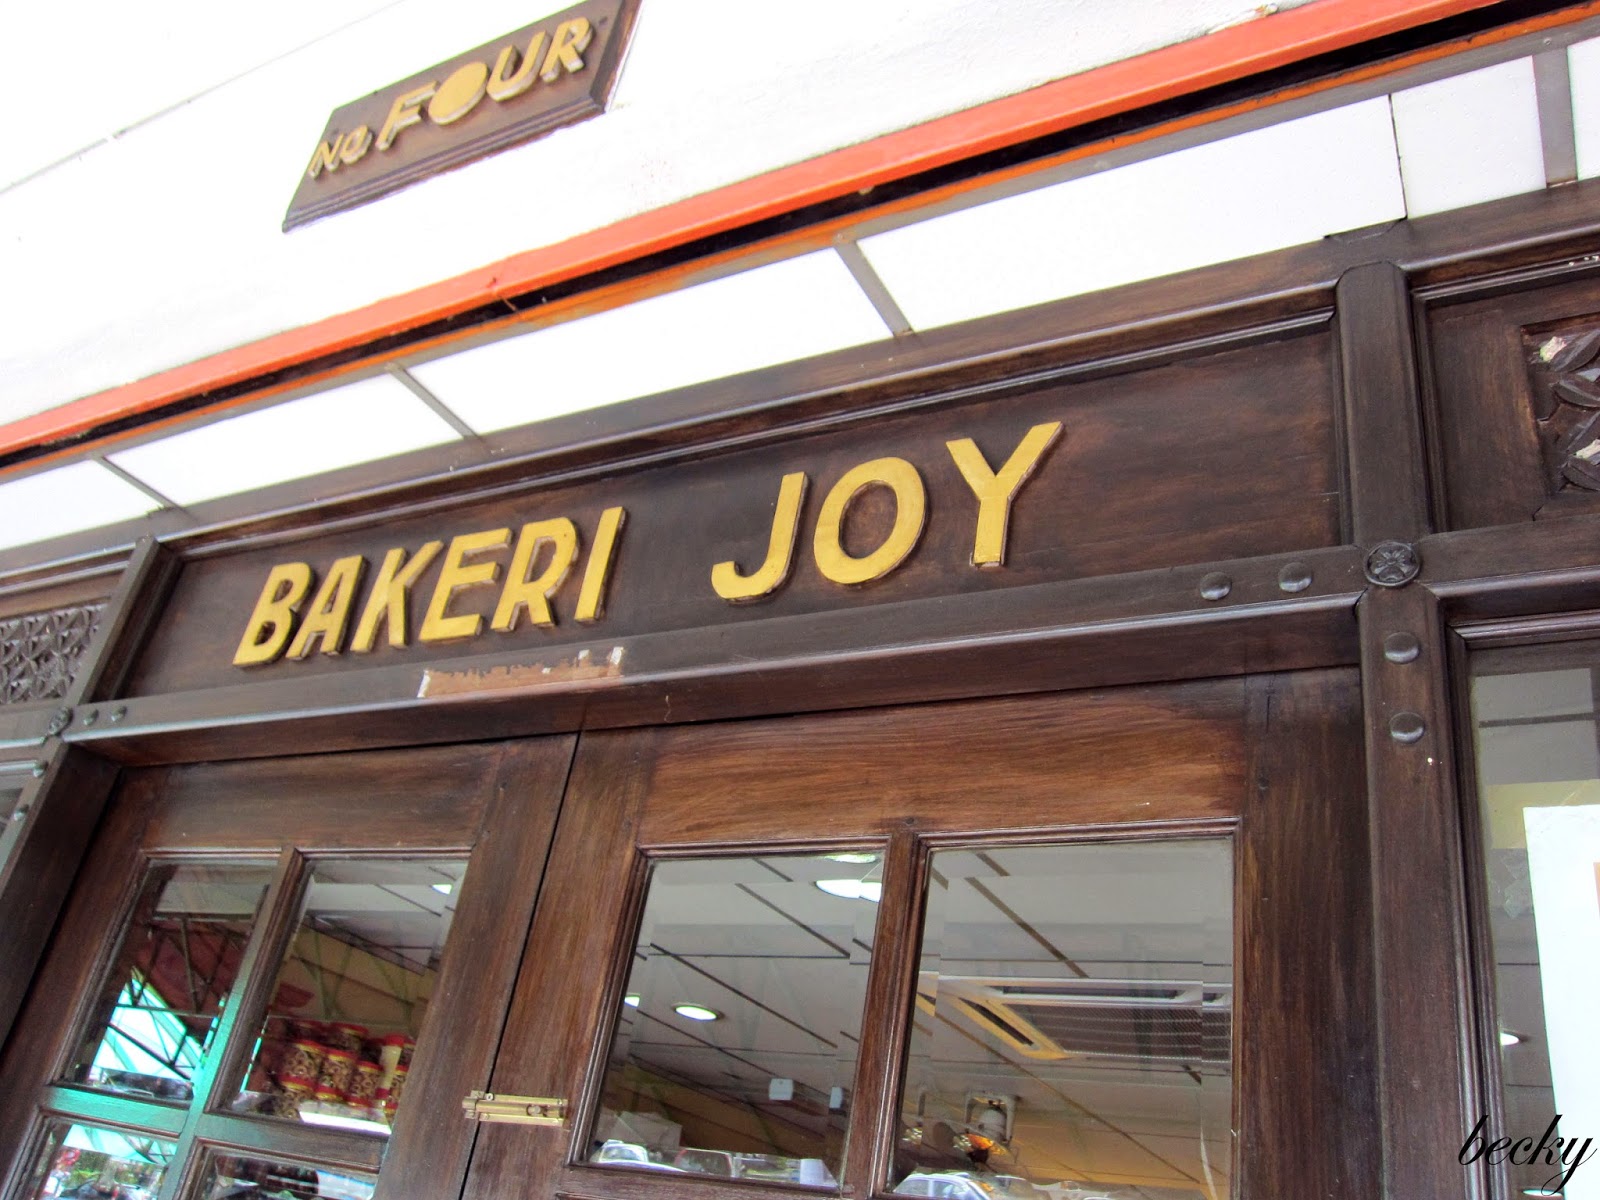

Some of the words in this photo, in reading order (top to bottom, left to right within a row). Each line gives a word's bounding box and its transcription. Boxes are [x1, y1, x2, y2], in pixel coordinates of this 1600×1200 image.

[375, 16, 593, 150] FOUR
[233, 507, 626, 667] BAKERI
[711, 421, 1063, 601] JOY
